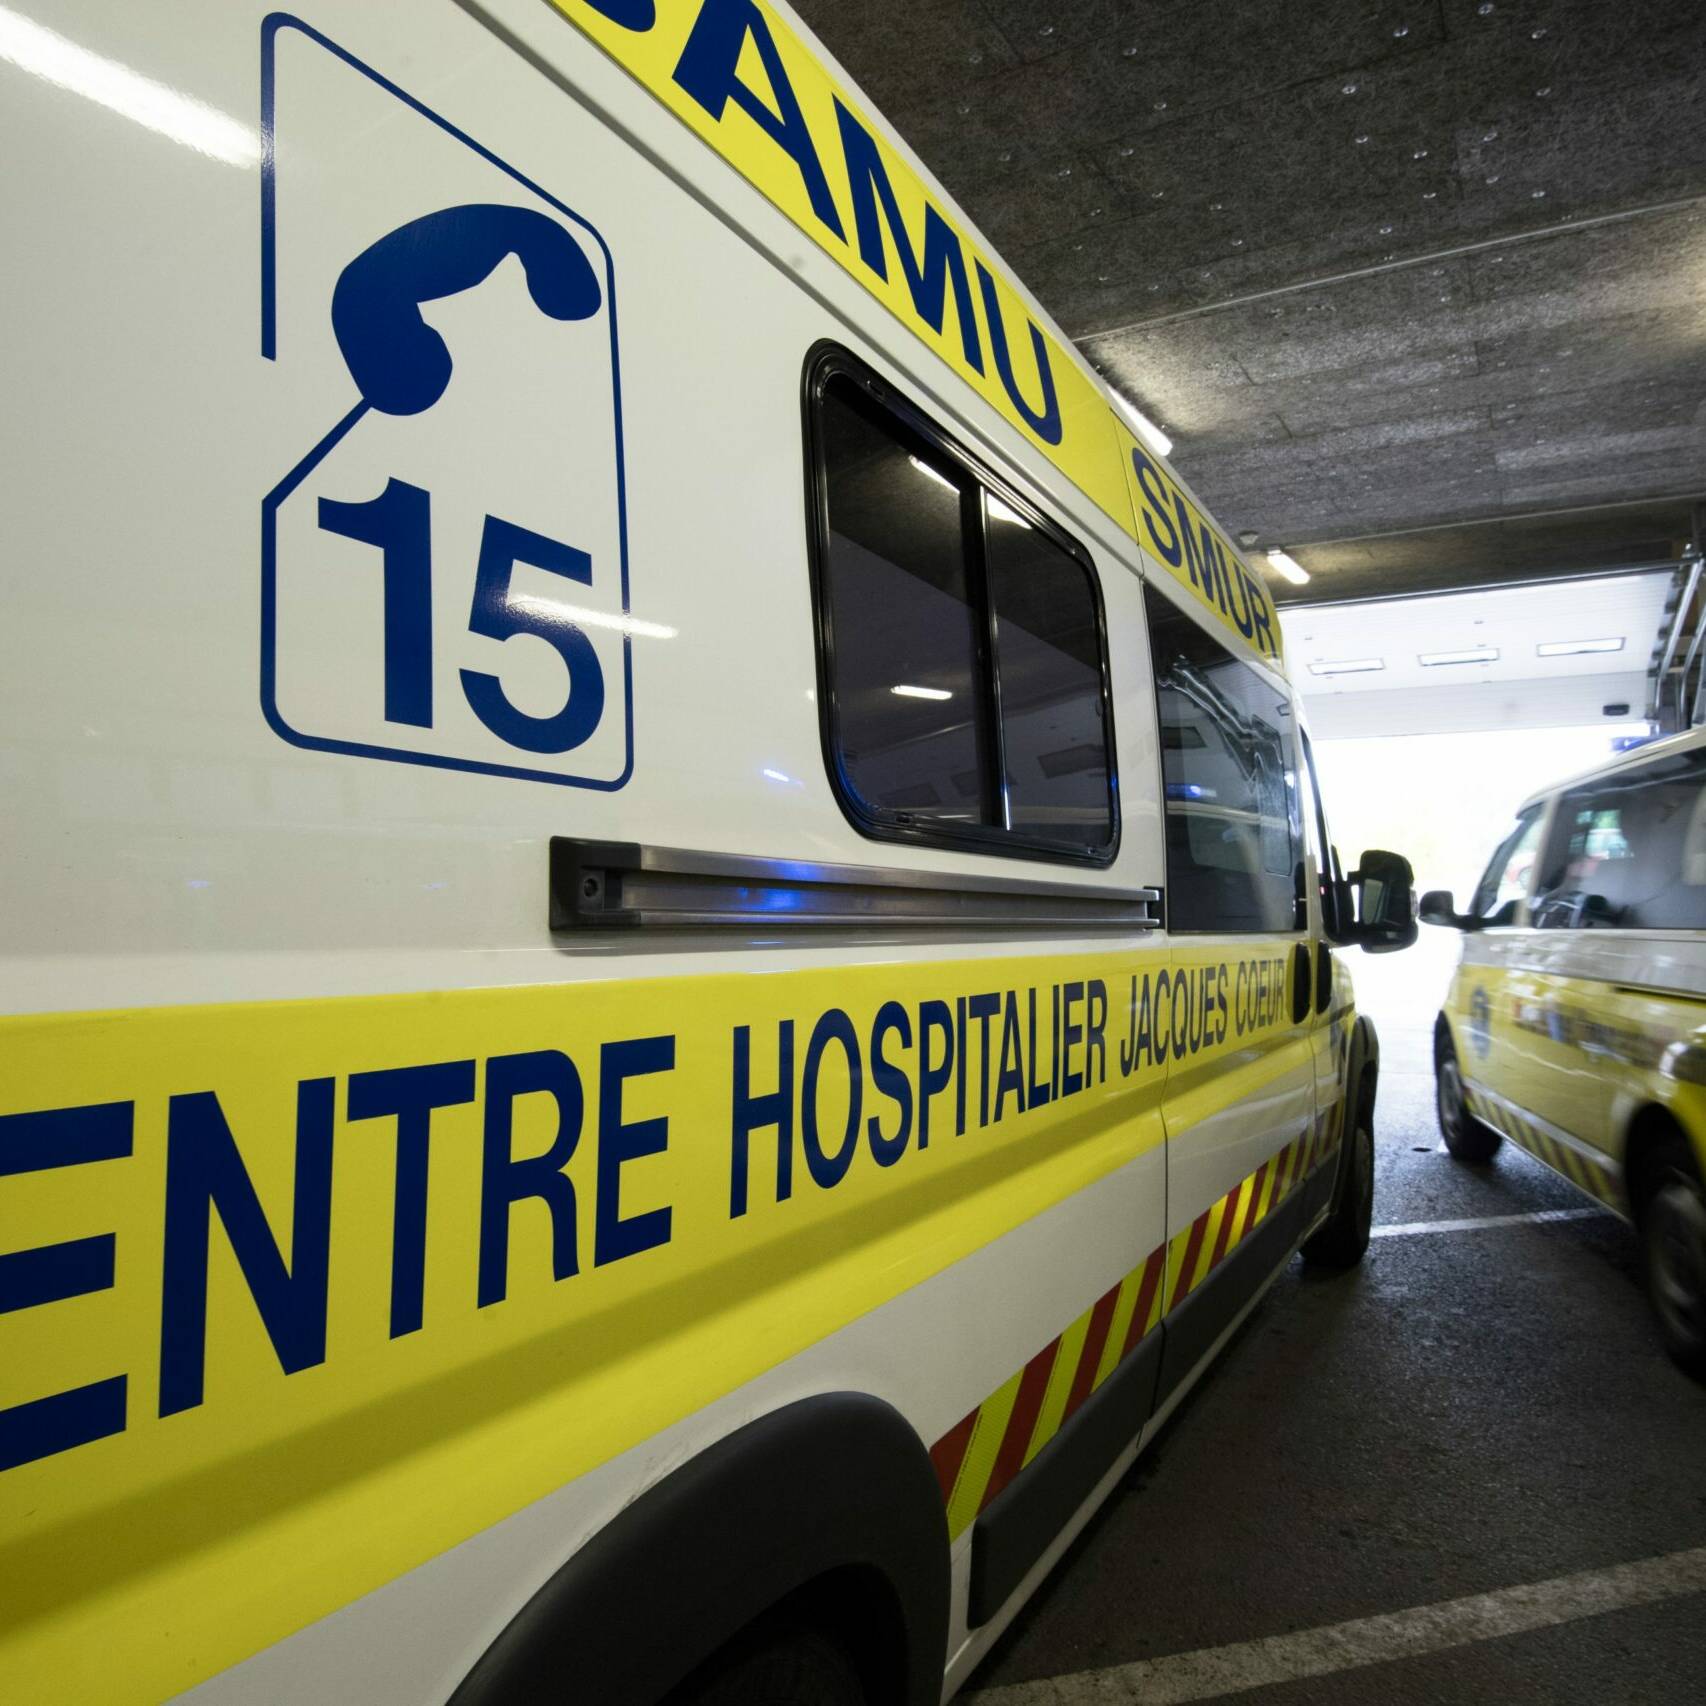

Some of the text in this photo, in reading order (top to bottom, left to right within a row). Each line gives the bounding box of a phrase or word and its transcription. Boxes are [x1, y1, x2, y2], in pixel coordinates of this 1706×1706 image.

[583, 0, 1062, 444] AMU
[317, 477, 605, 755] 15
[1131, 447, 1279, 659] SMUR
[731, 978, 1108, 1218] HOSPITALIER
[1120, 963, 1229, 1077] JACQUES
[1236, 958, 1285, 1037] COEUR
